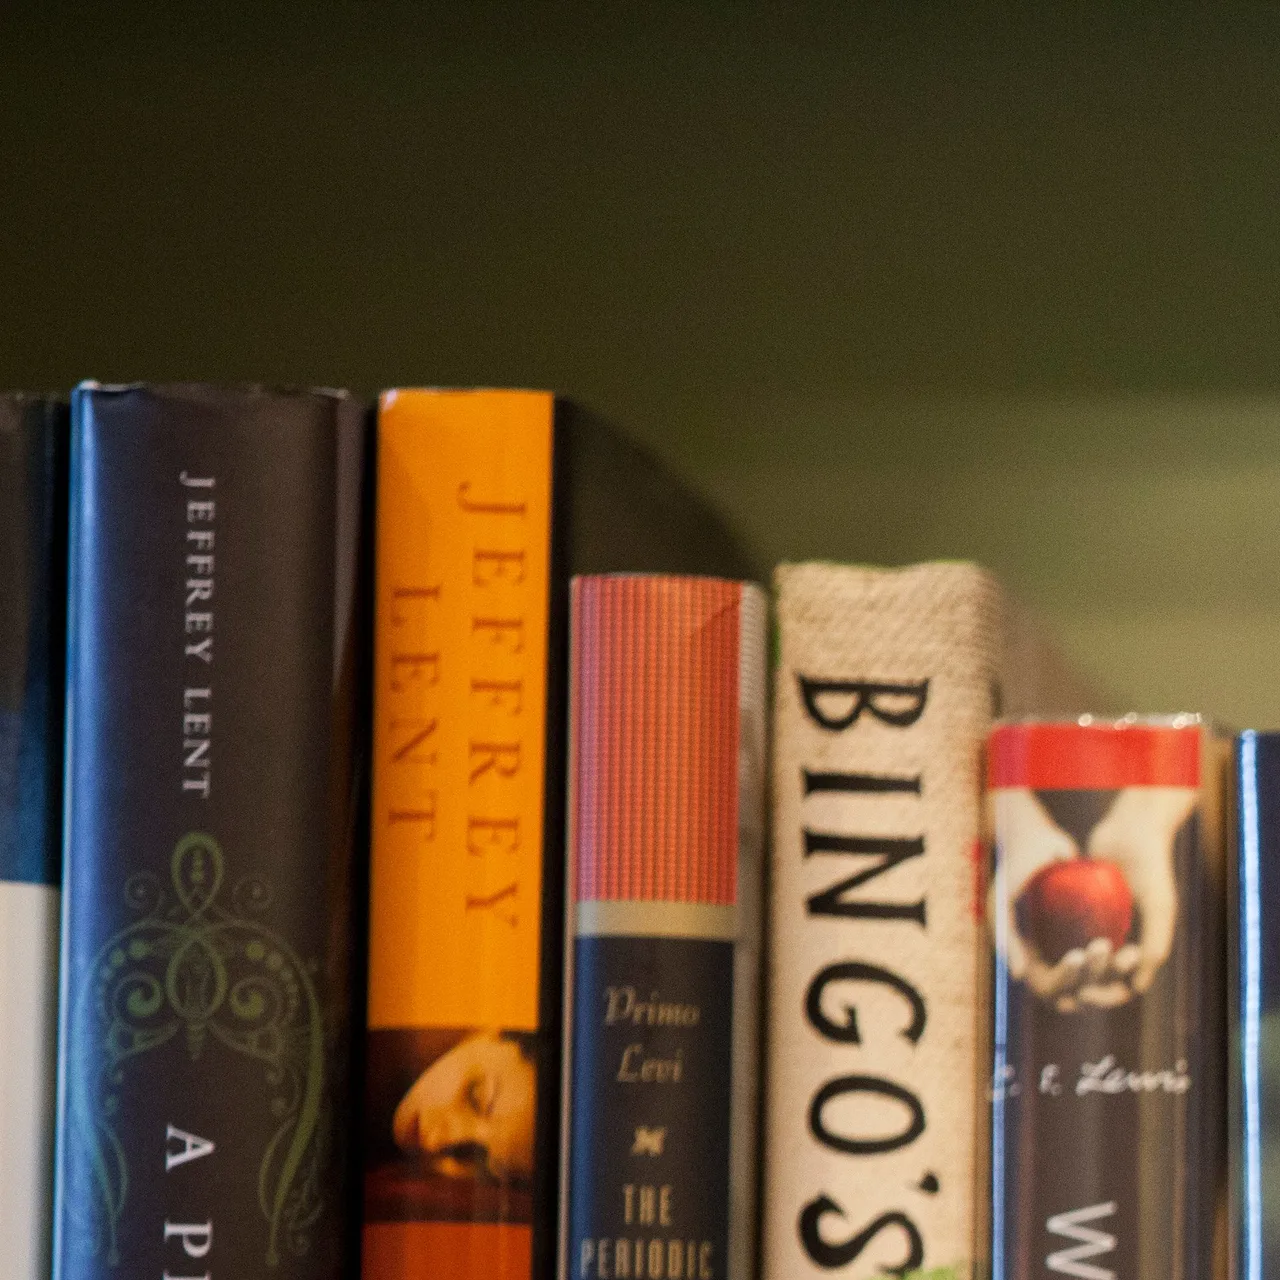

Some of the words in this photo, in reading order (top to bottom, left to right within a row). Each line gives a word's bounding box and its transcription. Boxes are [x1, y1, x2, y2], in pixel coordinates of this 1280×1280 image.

[179, 469, 216, 665] JEFFREY
[182, 686, 213, 797] LENT
[386, 581, 443, 843] LENT
[457, 483, 529, 929] JEFFREY
[602, 984, 701, 1028] Primo
[795, 671, 941, 1278] BINGO'S
[616, 1045, 686, 1083] Levi
[165, 1124, 215, 1173] A
[622, 1184, 673, 1226] THE
